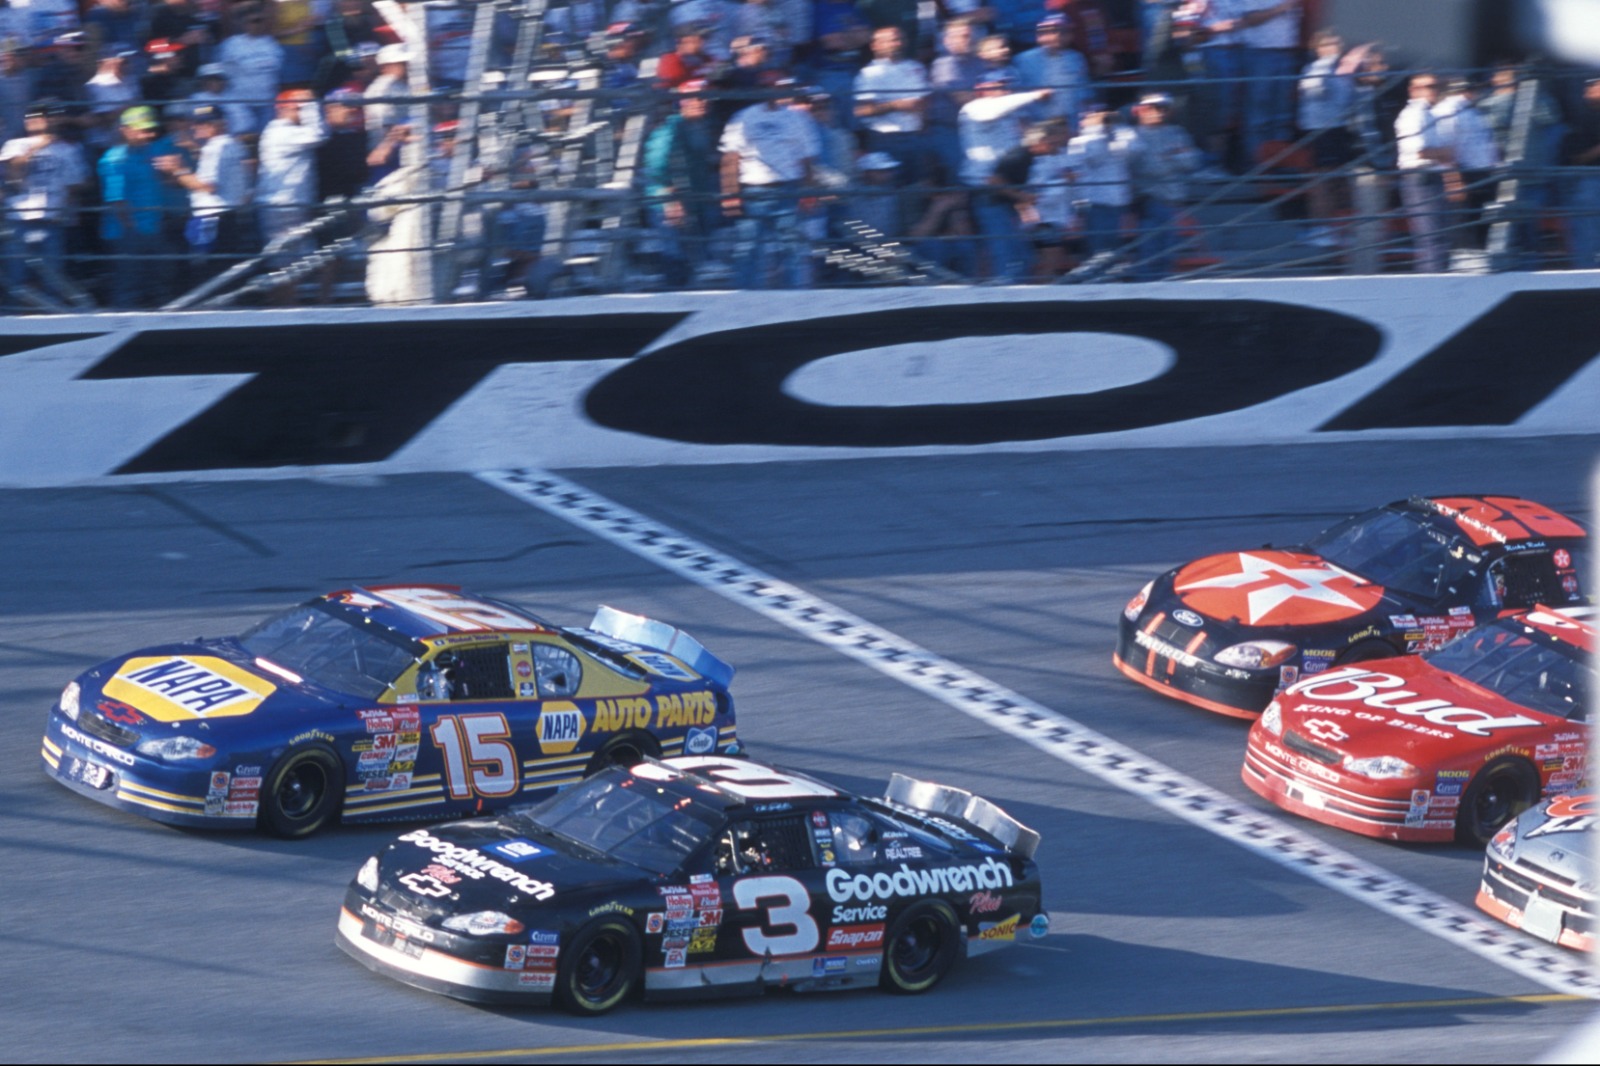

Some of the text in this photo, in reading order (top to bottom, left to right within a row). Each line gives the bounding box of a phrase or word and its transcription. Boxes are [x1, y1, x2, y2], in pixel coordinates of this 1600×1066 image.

[1134, 630, 1197, 667] TAURUS
[126, 660, 248, 712] NAPA
[1285, 667, 1544, 735] Bud
[543, 713, 578, 740] NAPA
[591, 691, 716, 733] AUTO PARTS
[1293, 704, 1454, 739] KING OF BEERS
[61, 724, 135, 766] MONTE CARLO
[374, 735, 396, 750] 3M
[429, 711, 520, 800] 15
[1265, 742, 1340, 783] MONTE CARLO
[1437, 770, 1469, 778] MOOG
[1562, 756, 1583, 771] 3M
[398, 829, 555, 900] Goodwrench
[825, 857, 1013, 902] Goodwrench
[700, 911, 721, 926] 3M
[732, 875, 819, 956] 3
[831, 903, 888, 924] Service
[970, 890, 1002, 914] Plus
[828, 929, 883, 946] Snap-on
[980, 922, 1016, 940] SONIC
